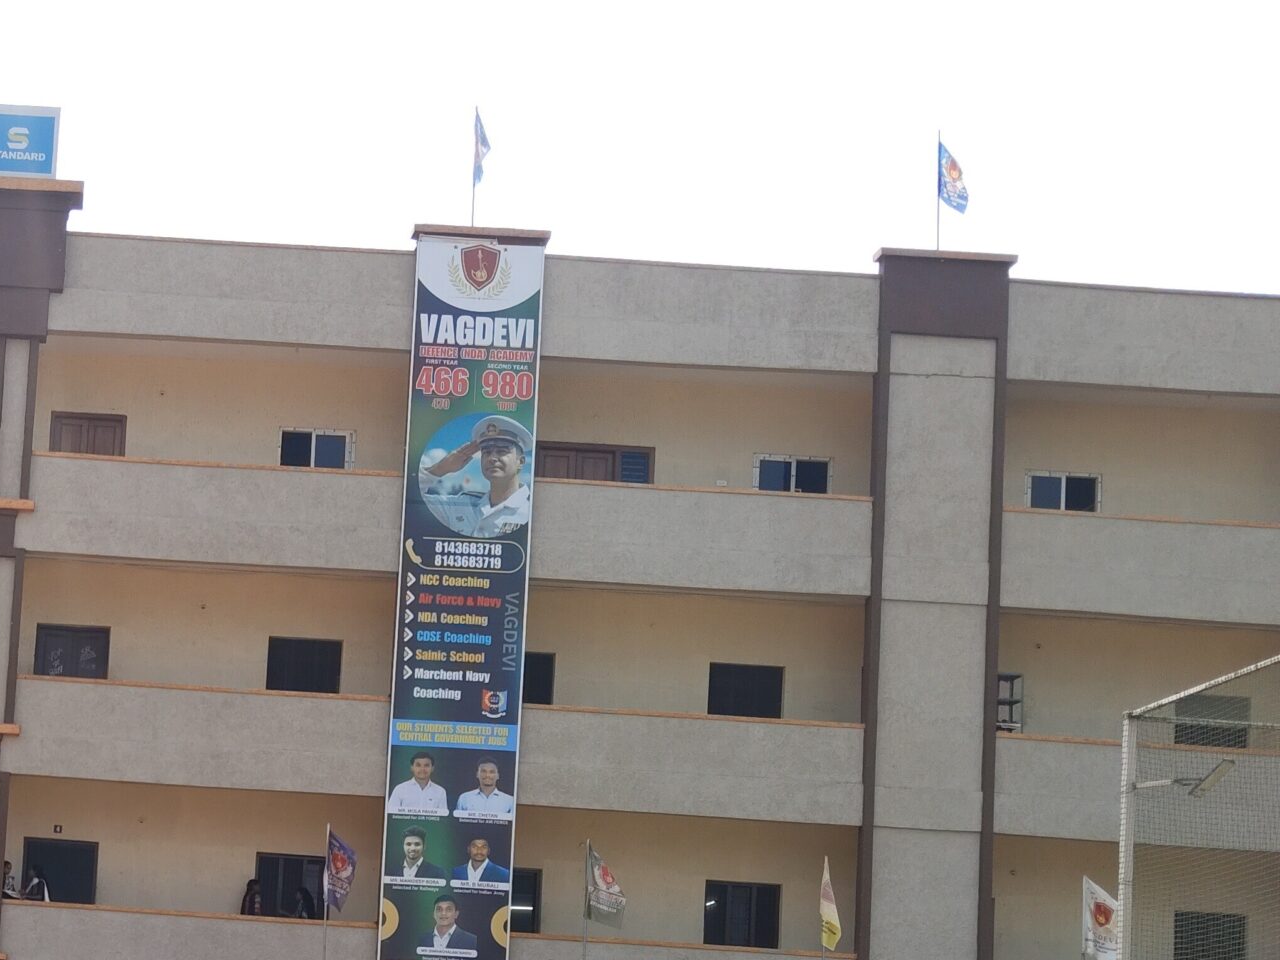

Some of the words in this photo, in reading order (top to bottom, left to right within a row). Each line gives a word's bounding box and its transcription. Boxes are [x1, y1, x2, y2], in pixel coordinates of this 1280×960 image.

[420, 313, 535, 349] VAGDEVI
[419, 346, 458, 358] DEFENCE
[460, 348, 487, 360] (NDA)
[489, 349, 535, 362] ACADEMY
[416, 366, 469, 396] 466
[481, 370, 533, 400] 980
[435, 541, 502, 556] 8143683718
[434, 555, 502, 569] 8143683719
[420, 574, 439, 586] NCC
[442, 575, 490, 589] Coaching
[418, 592, 434, 605] Air
[436, 594, 464, 606] Force
[466, 595, 475, 606] &
[477, 595, 502, 608] Navy
[418, 612, 437, 623] NDA
[440, 613, 489, 627] Coaching
[416, 630, 441, 642] CDSE
[444, 632, 492, 646] Coaching
[502, 592, 520, 671] VAGDEVI
[415, 649, 447, 662] Sainic
[449, 651, 485, 664] School
[414, 668, 463, 681] Marchent
[465, 671, 490, 683] Navy
[413, 687, 462, 701] Coaching
[396, 722, 413, 731] OUR
[415, 723, 453, 733] STUDENTS
[455, 725, 491, 735] SELECTED
[494, 727, 509, 737] FOR
[399, 732, 432, 742] CENTRAL
[434, 734, 485, 744] GOVERNMENT
[488, 736, 507, 746] JOBS
